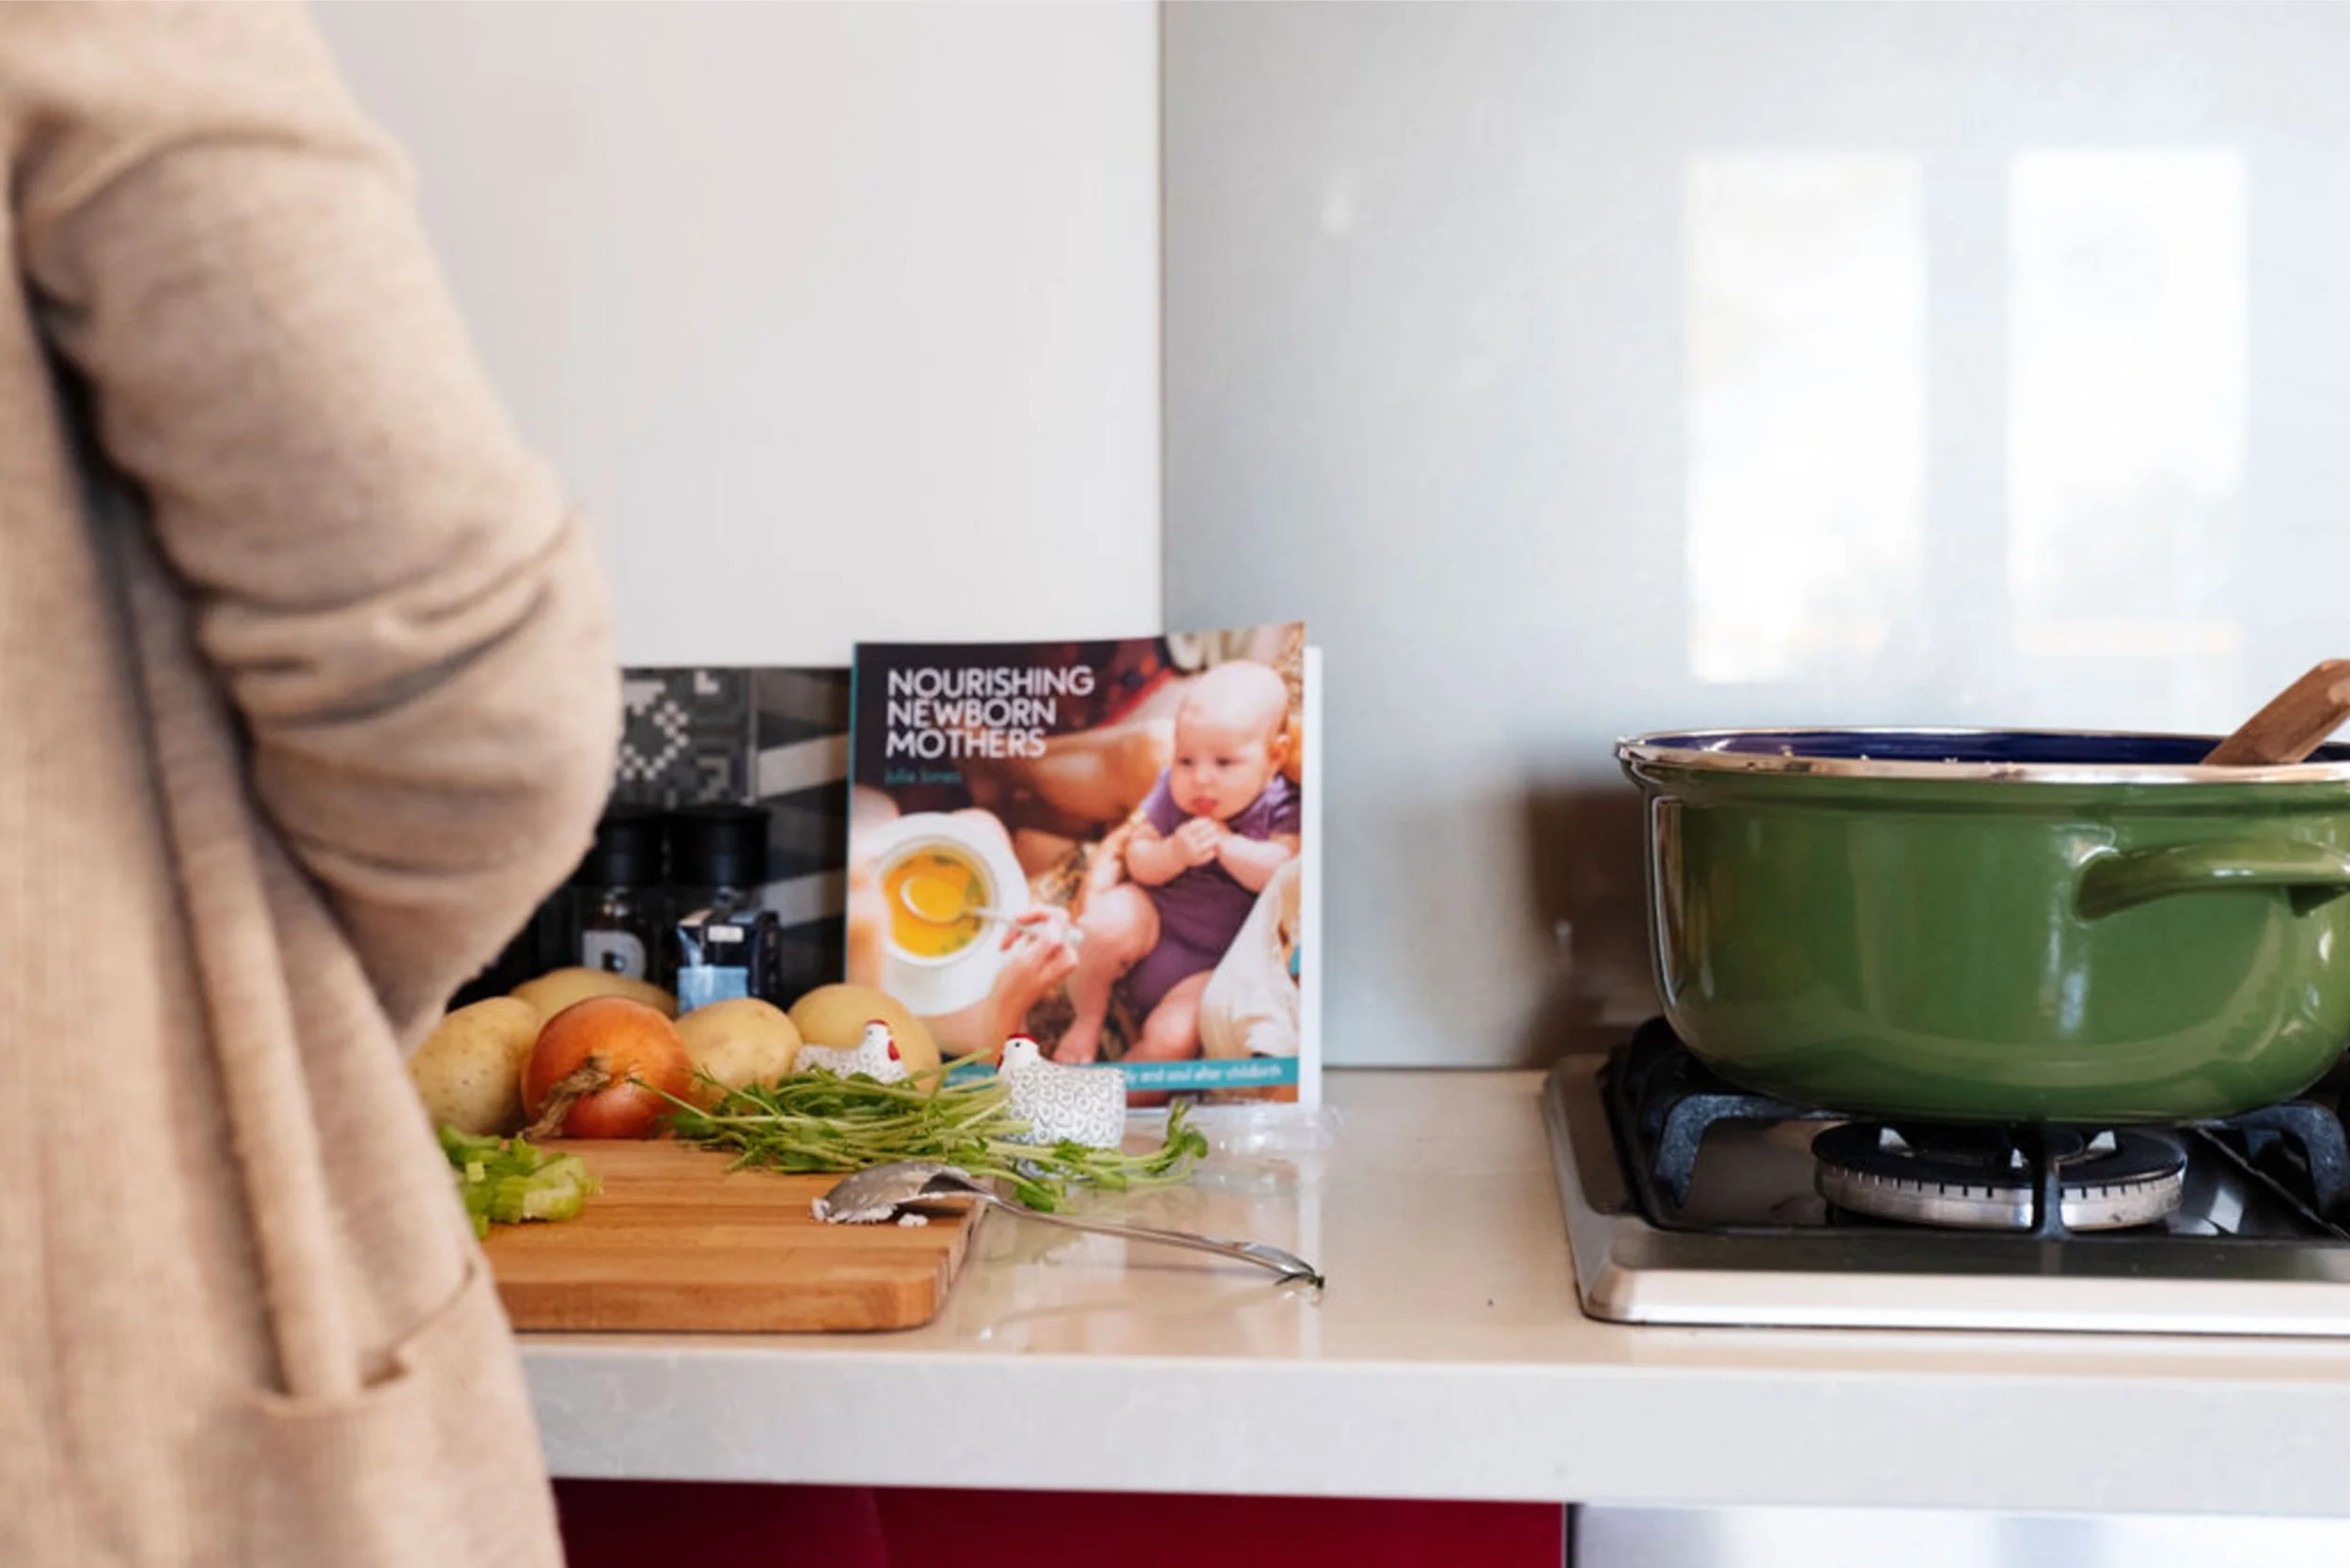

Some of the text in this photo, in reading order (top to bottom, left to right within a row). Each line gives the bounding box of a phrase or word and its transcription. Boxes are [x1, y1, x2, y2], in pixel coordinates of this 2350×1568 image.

[887, 665, 1095, 698] NOURISHING
[886, 698, 1057, 728] NEWBORN
[885, 728, 1047, 758] MOTHERS
[1141, 1068, 1165, 1082] and
[1195, 1064, 1221, 1081] after
